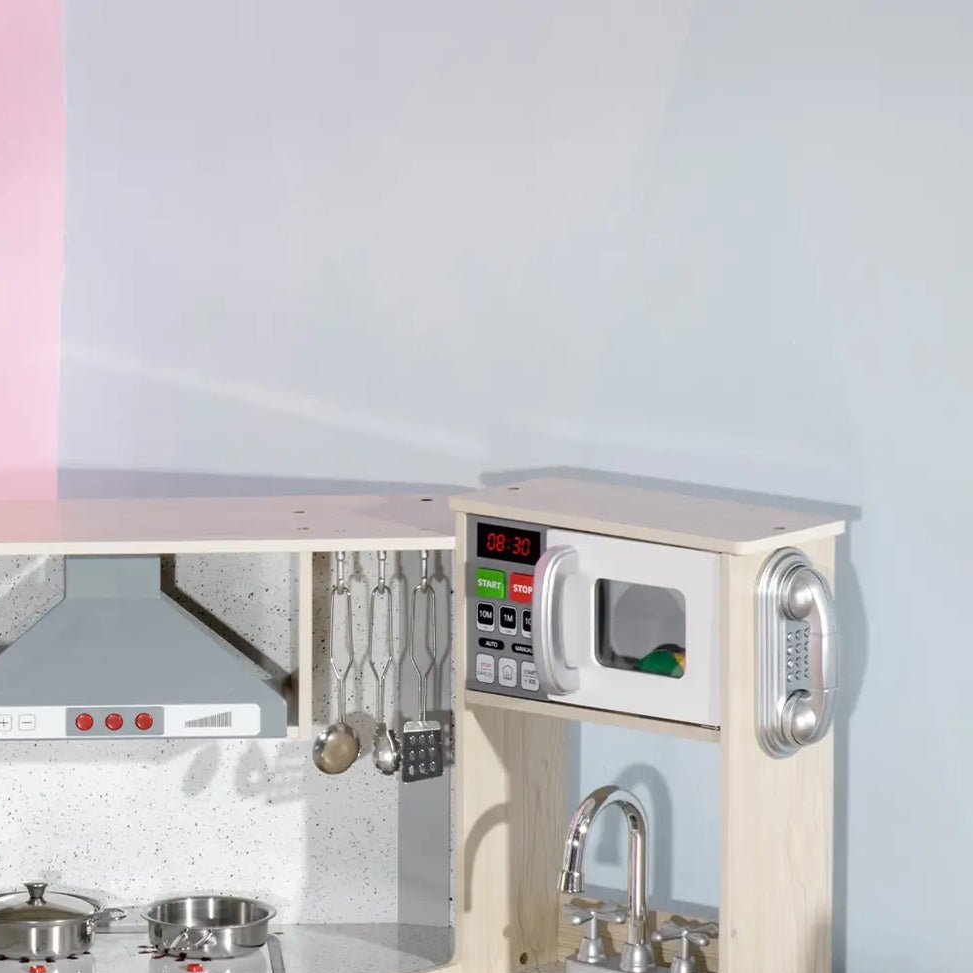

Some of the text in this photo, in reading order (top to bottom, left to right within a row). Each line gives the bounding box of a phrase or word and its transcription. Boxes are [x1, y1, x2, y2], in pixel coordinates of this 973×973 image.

[486, 532, 531, 556] 08:30
[477, 578, 502, 590] START
[513, 583, 533, 595] STOP
[479, 610, 493, 619] 10M
[503, 613, 514, 623] 1M
[484, 640, 499, 648] AUTO
